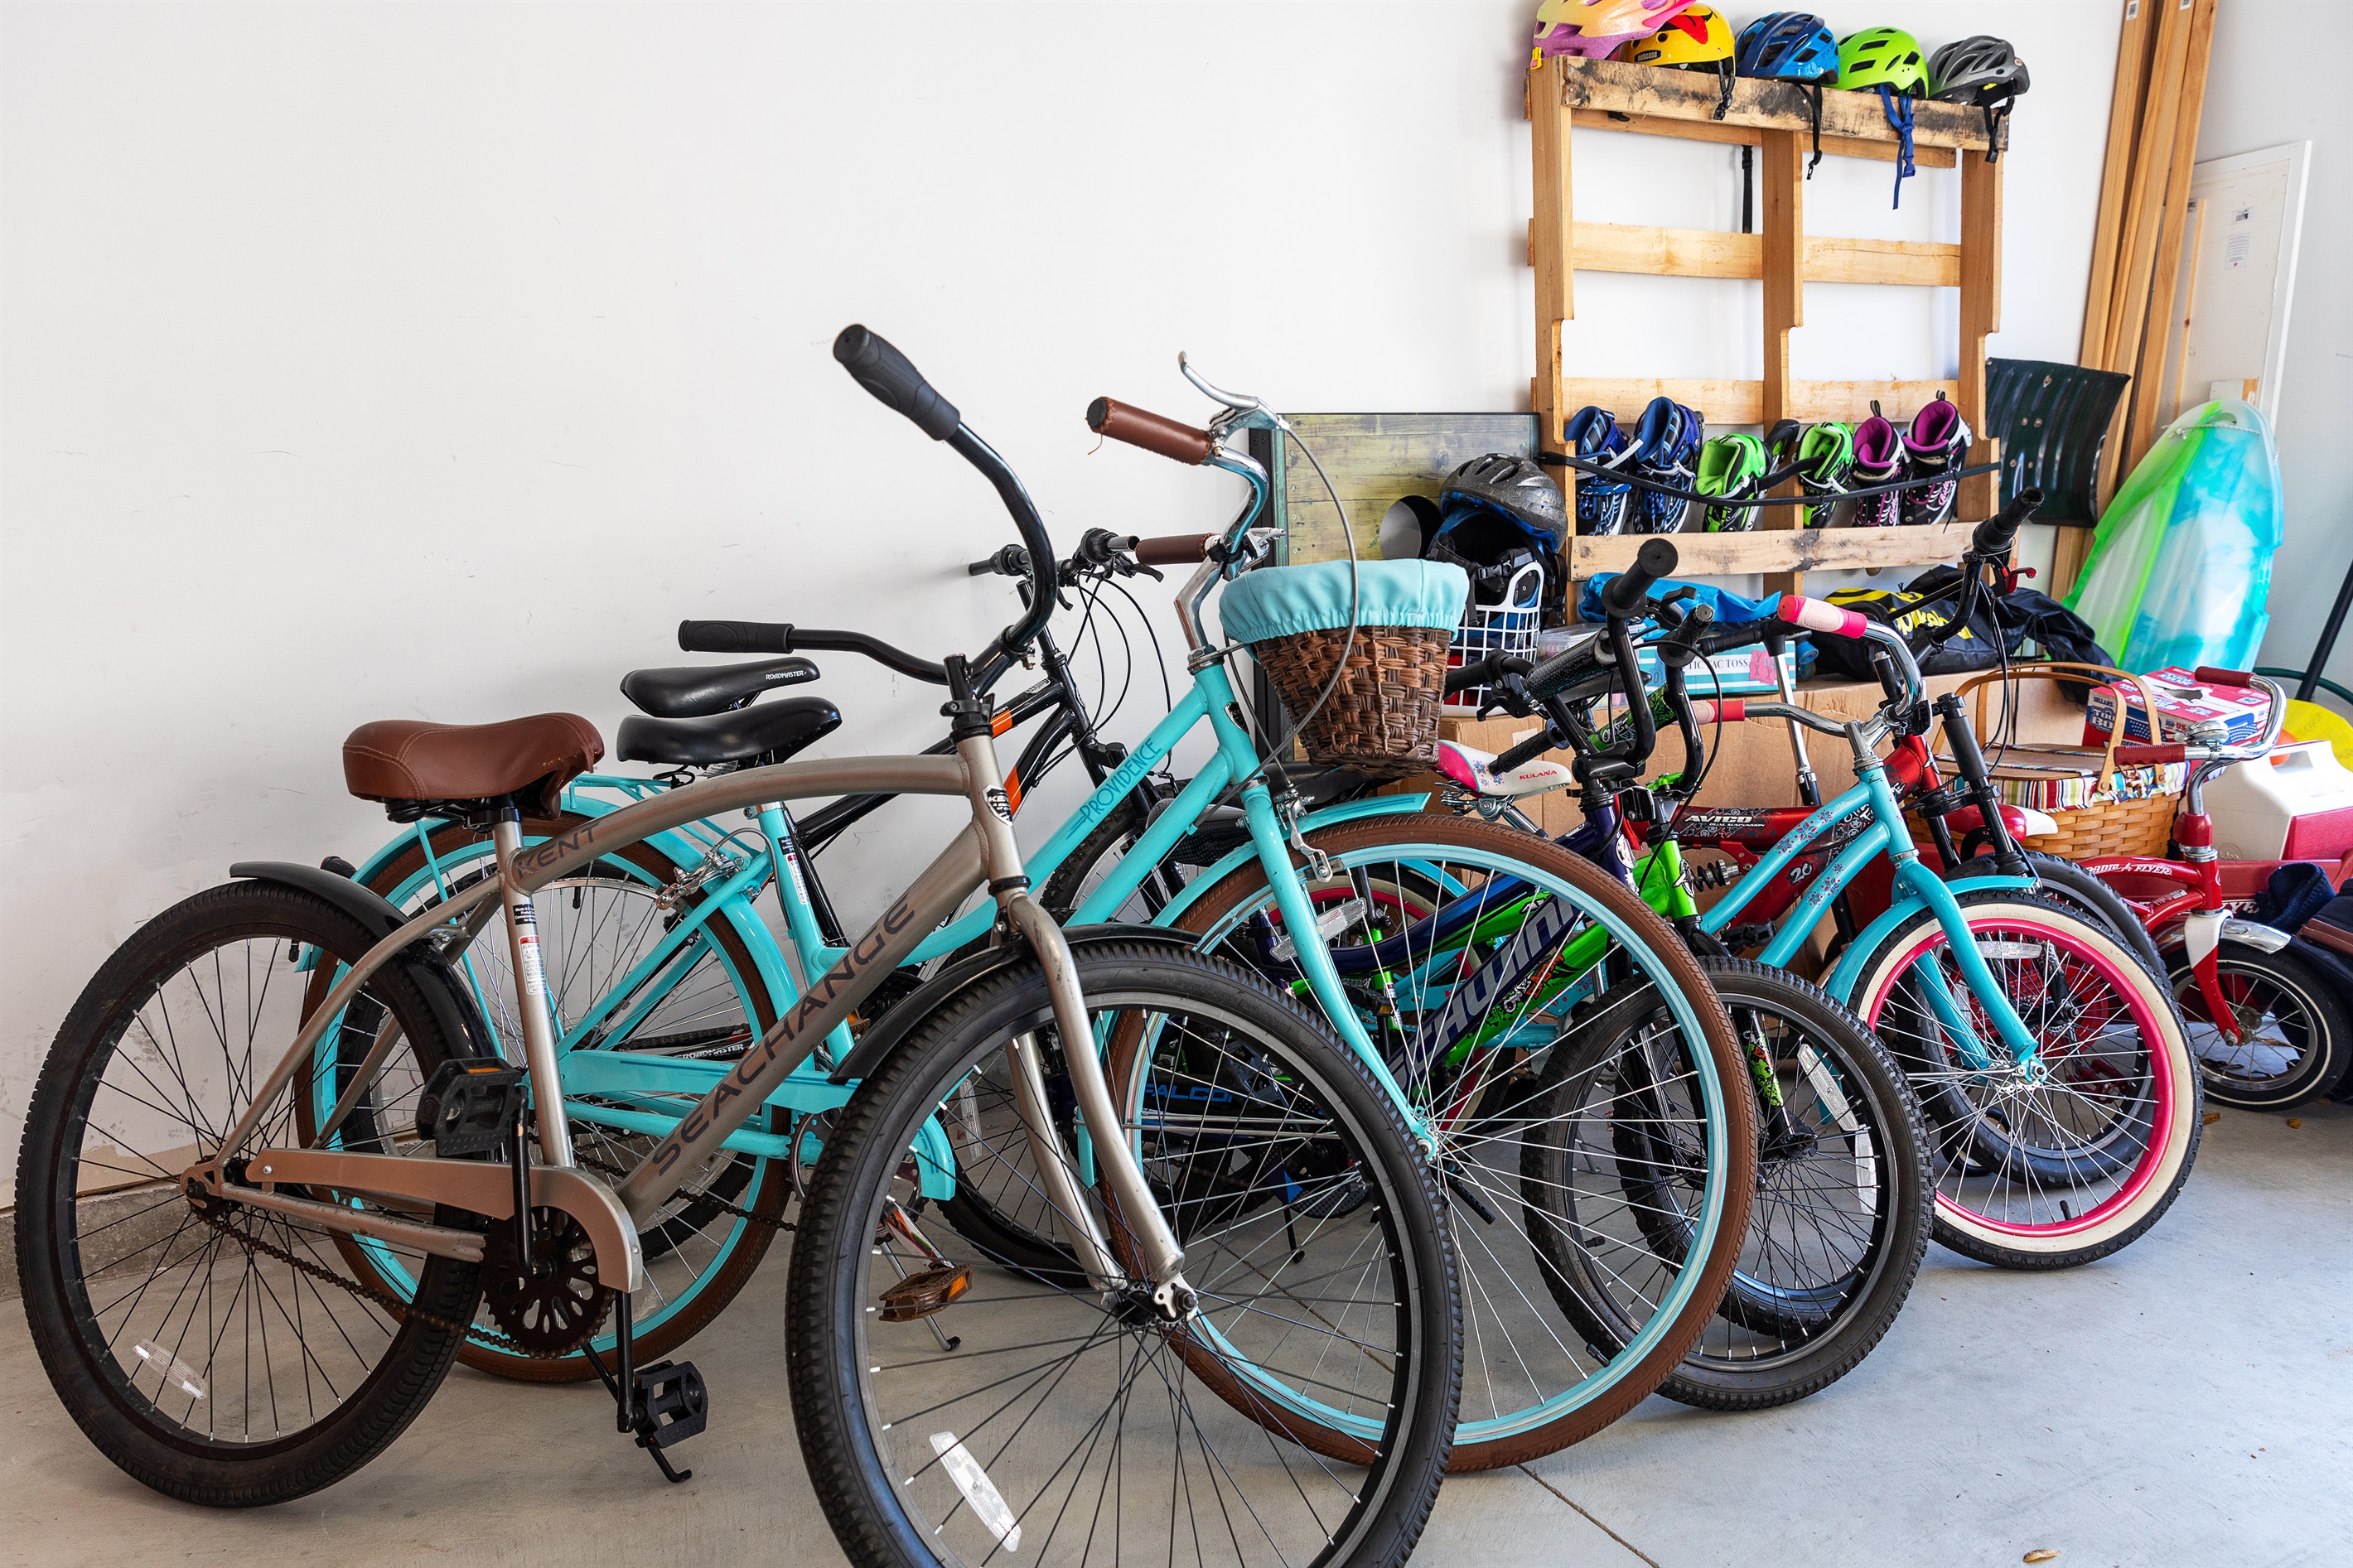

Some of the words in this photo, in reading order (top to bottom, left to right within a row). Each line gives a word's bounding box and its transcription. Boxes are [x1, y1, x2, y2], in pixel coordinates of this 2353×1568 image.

[1689, 660, 1703, 670] TIC
[1709, 659, 1724, 669] AC
[1727, 659, 1748, 668] TOSS
[766, 670, 804, 681] ROADMASTER
[2091, 707, 2116, 721] TOO
[2091, 717, 2114, 730] BO
[1080, 737, 1162, 823] PROVIDENCE
[1519, 770, 1558, 780] KULANA
[516, 822, 601, 880] KENT
[1790, 862, 1813, 885] 20
[2086, 863, 2119, 874] RADIO
[2133, 864, 2172, 876] FLYER
[651, 903, 915, 1177] SEACHANGE
